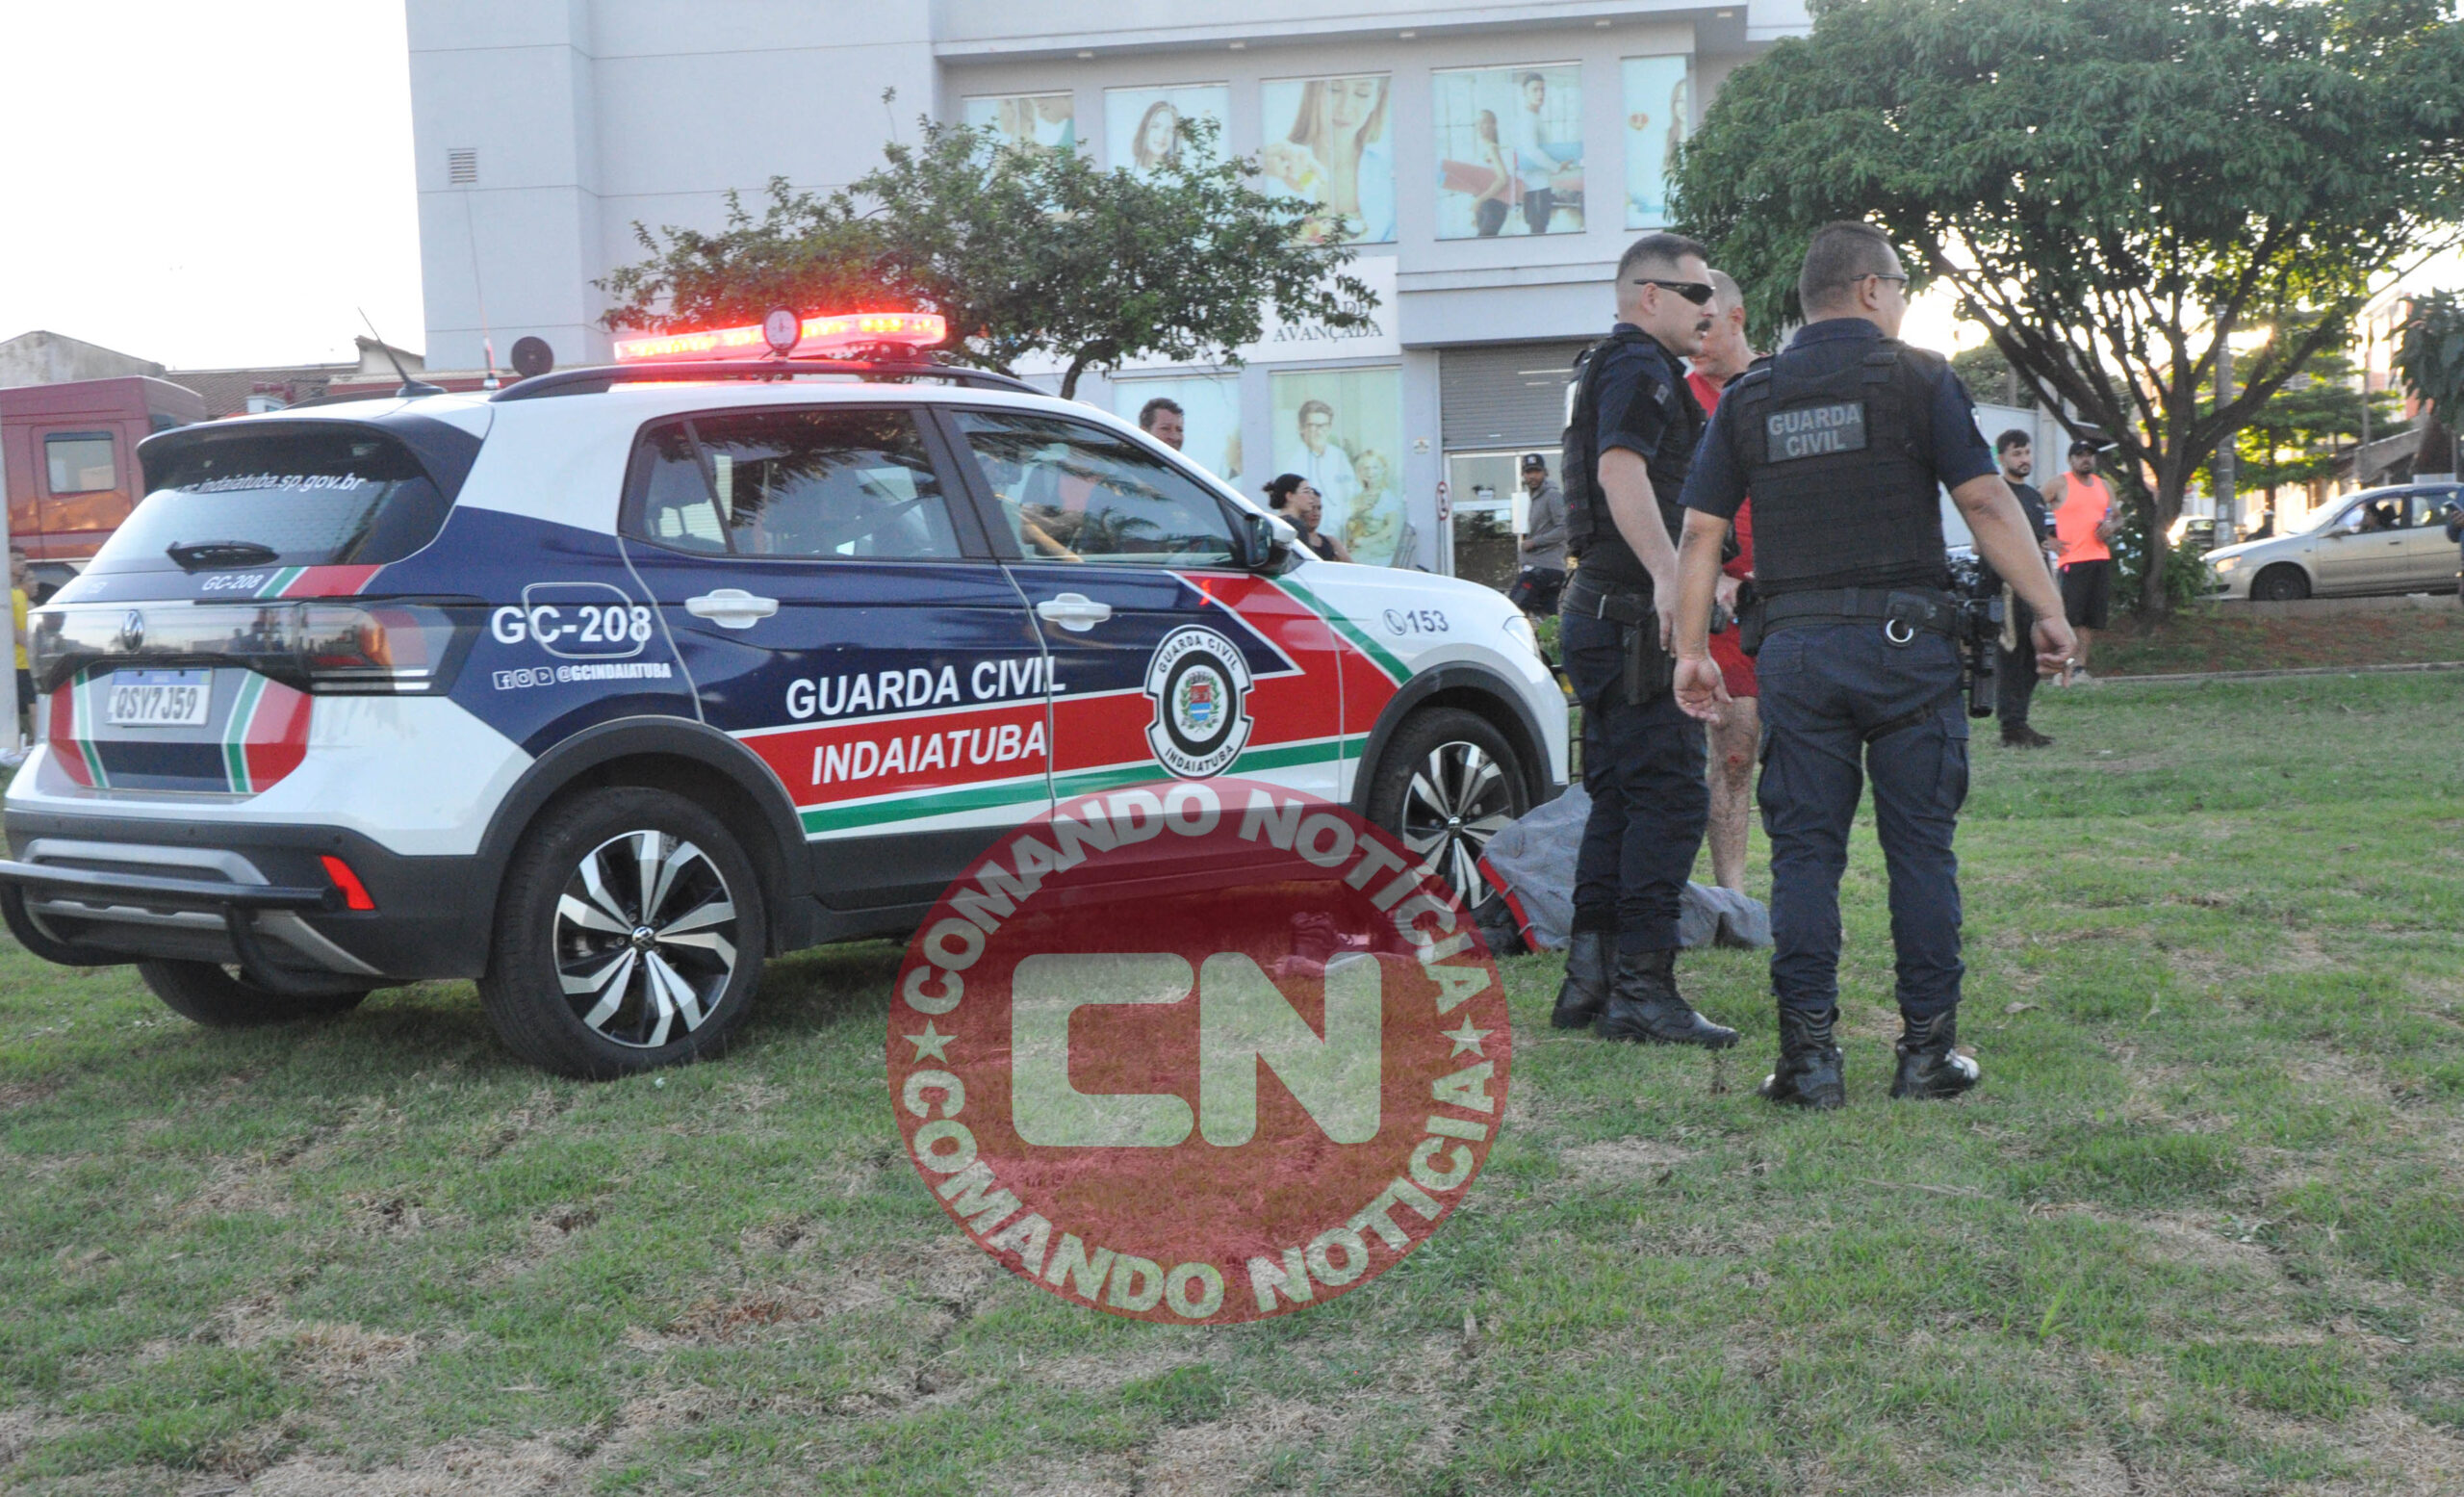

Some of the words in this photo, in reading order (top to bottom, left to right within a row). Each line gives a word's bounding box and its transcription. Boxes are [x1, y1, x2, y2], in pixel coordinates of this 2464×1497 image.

[1273, 323, 1383, 343] AVANÇADA
[1768, 403, 1861, 436] GUARDA
[1785, 429, 1847, 457] CIVIL
[201, 574, 265, 591] GC-208
[491, 606, 652, 644] GC-208
[1406, 609, 1450, 633] 153
[1158, 634, 1202, 674] GUARDA
[1207, 637, 1239, 671] CIVIL
[555, 662, 672, 683] @GCINDAIATUBA
[785, 665, 961, 720] GUARDA
[971, 656, 1066, 700] CIVIL
[116, 686, 198, 720] QSY7J59
[811, 720, 1048, 786] INDAIATUBA
[1165, 744, 1235, 773] INDAIATUBA
